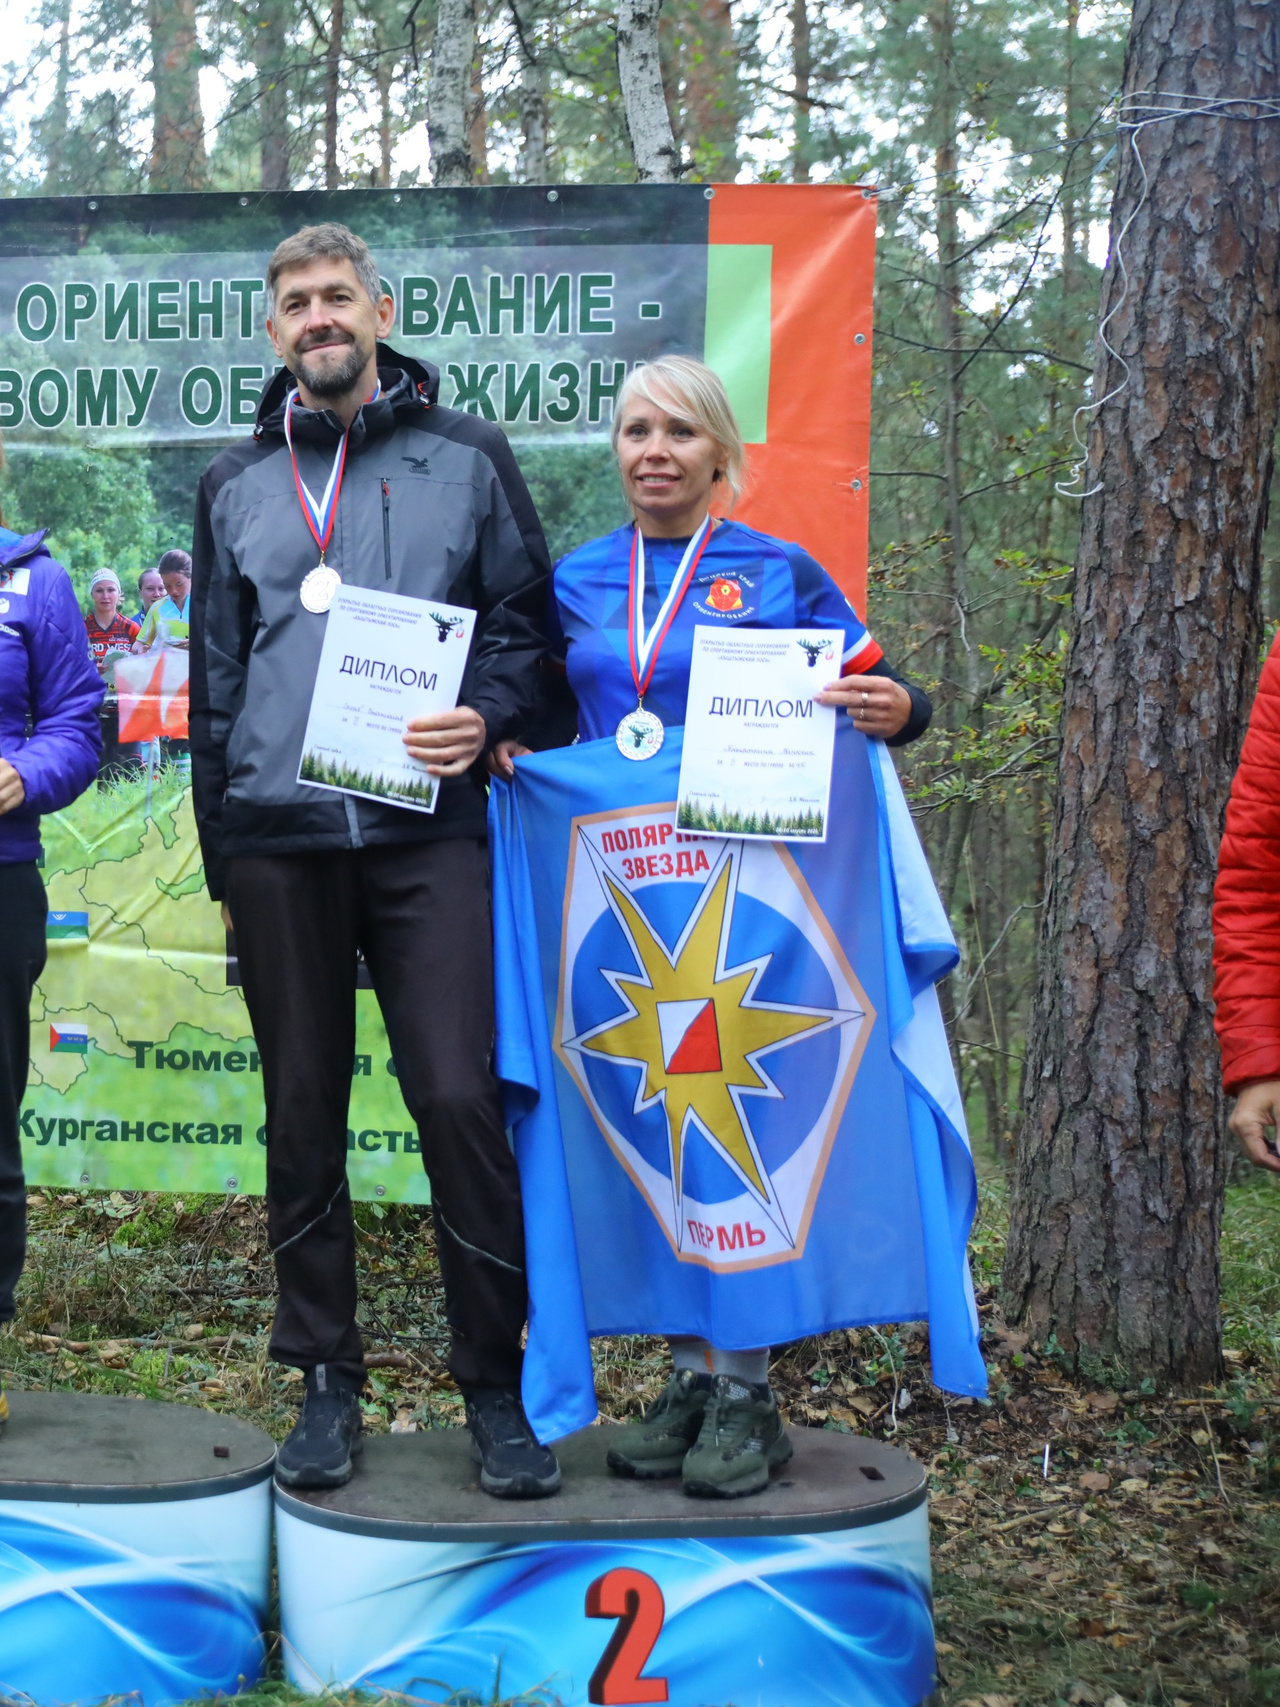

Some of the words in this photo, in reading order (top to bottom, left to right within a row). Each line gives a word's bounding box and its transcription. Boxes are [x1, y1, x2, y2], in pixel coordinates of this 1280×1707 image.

[17, 272, 615, 342] ОРИЕНТВАНИЕ
[447, 360, 644, 424] ЖИЗН
[339, 655, 438, 691] ДИПЛОМ
[708, 696, 813, 718] ДИПЛОМ
[601, 823, 716, 854] ПОЛЯР
[621, 849, 710, 881] ЗВЕЗДА
[18, 1108, 243, 1147] Курганская
[686, 1219, 766, 1252] ПЕРМЬ
[585, 1567, 669, 1706] 2
